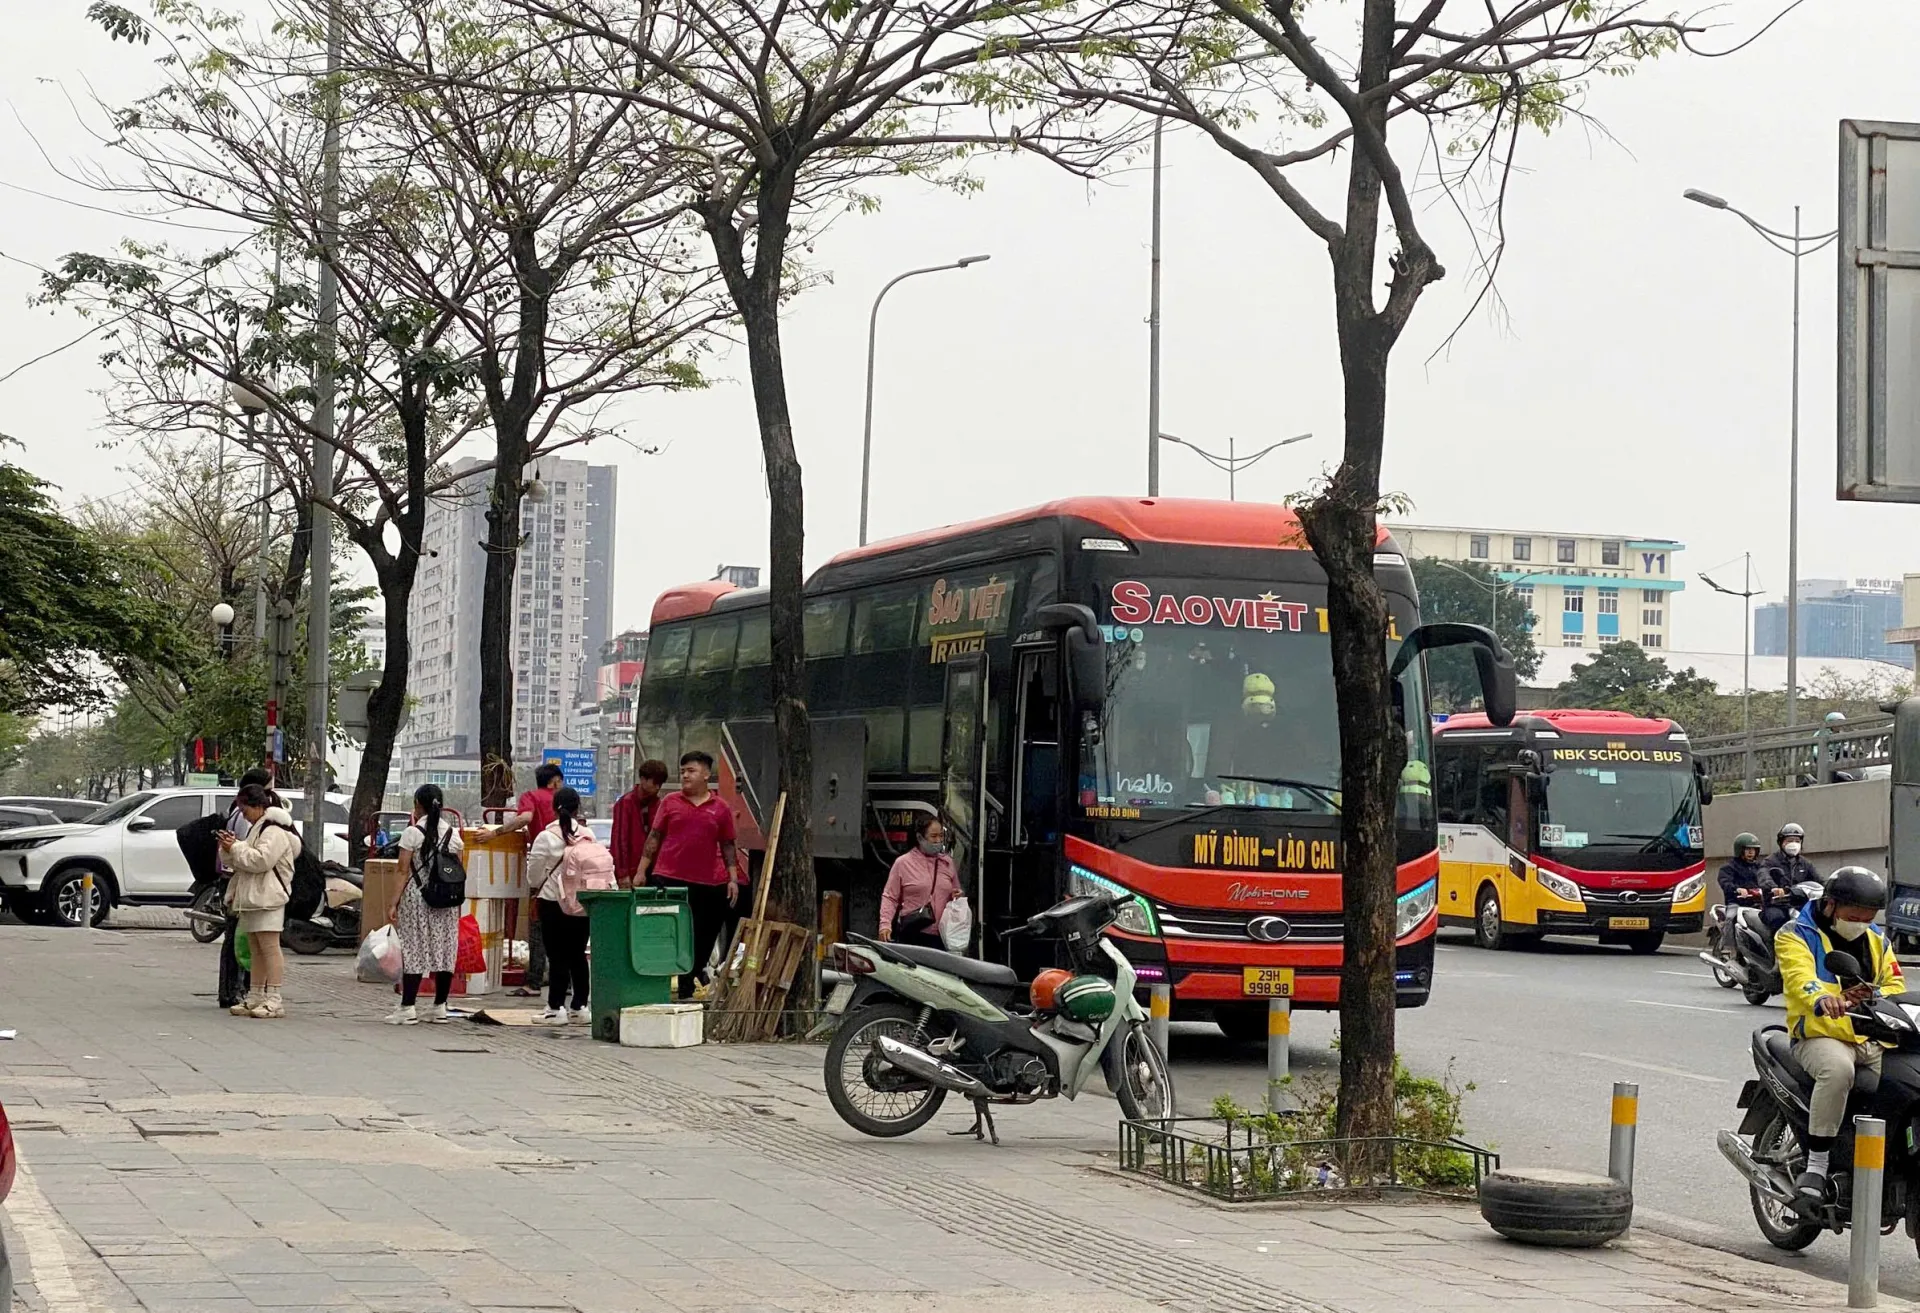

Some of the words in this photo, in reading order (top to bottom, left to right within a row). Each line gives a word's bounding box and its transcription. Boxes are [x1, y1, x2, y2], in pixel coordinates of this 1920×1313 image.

[1642, 553, 1665, 574] Y1
[928, 578, 964, 625] SAO
[1553, 749, 1586, 760] NBK
[1589, 749, 1651, 761] SCHOOL
[1653, 751, 1683, 763] BUS
[1116, 771, 1173, 793] hello
[1194, 829, 1217, 865] MỸ
[1223, 830, 1260, 867] ĐÌNH
[1277, 832, 1306, 869] LÀO
[1311, 840, 1336, 870] CAI
[1258, 970, 1280, 981] 29H
[1249, 982, 1289, 995] 998.98
